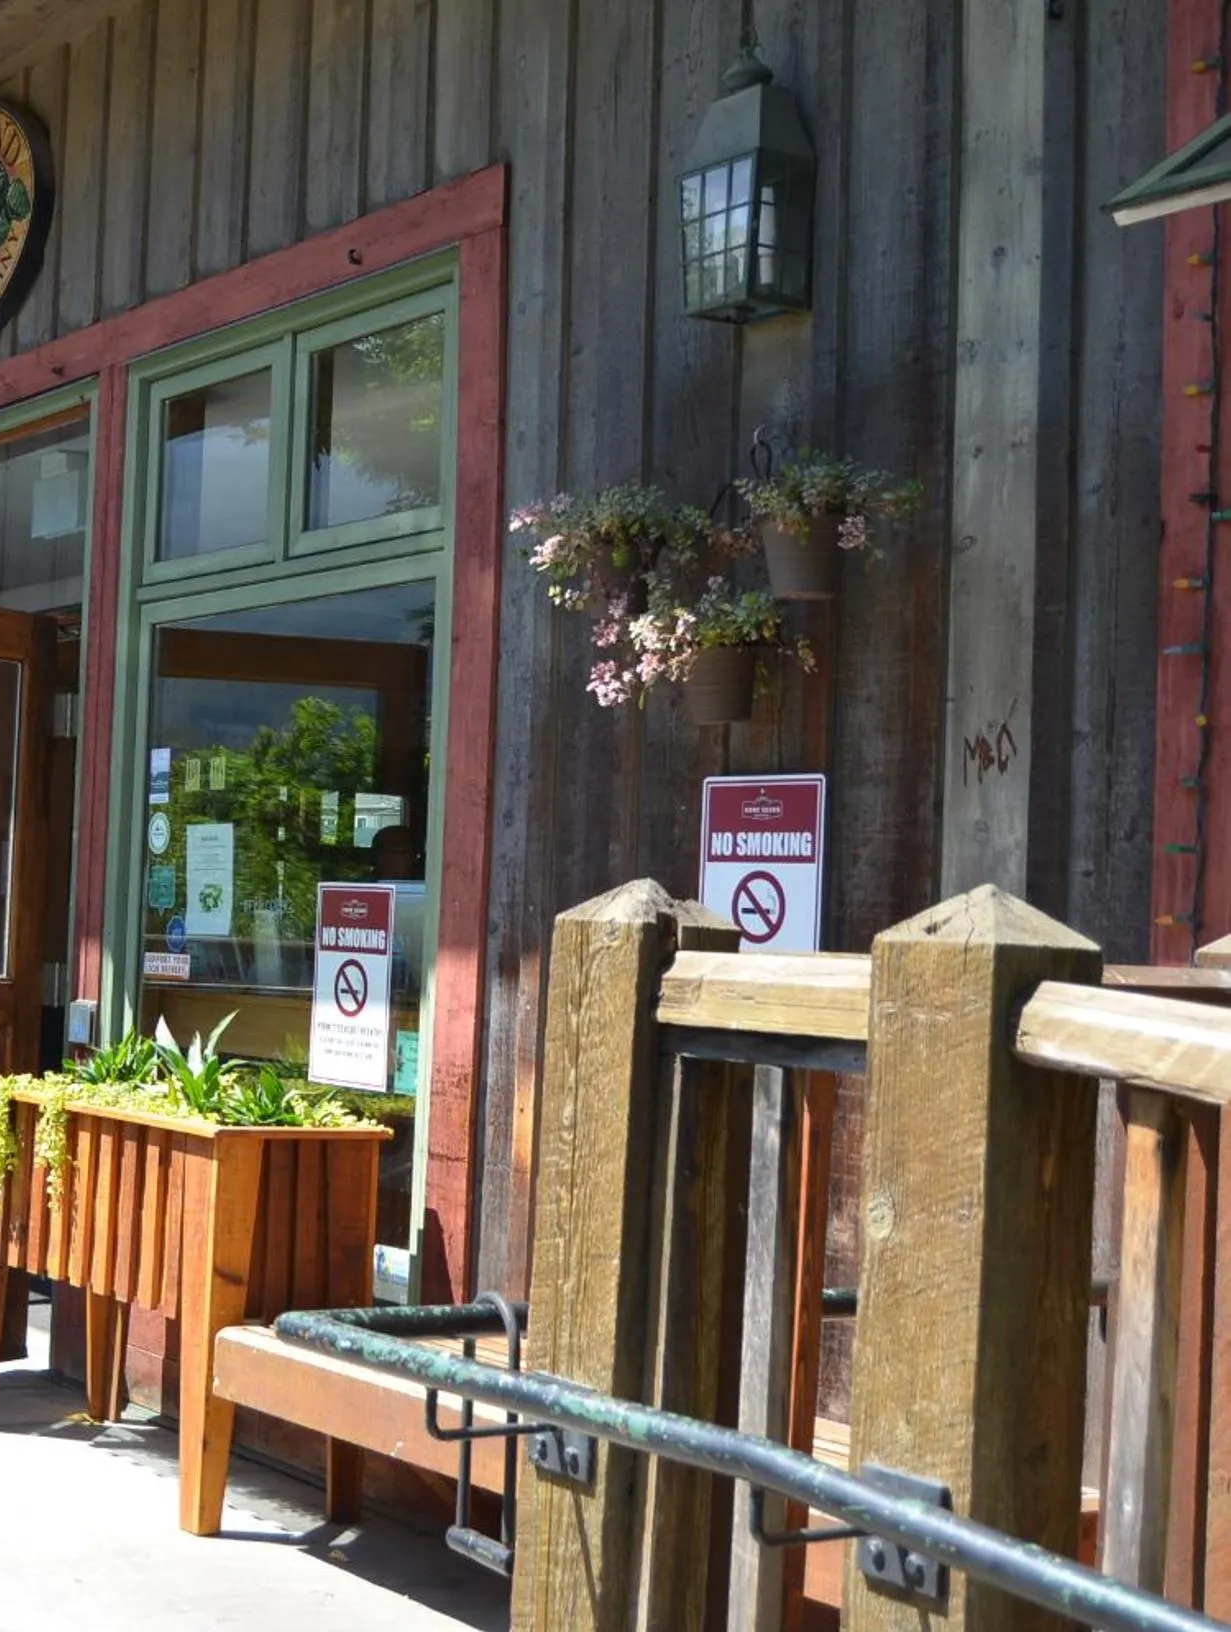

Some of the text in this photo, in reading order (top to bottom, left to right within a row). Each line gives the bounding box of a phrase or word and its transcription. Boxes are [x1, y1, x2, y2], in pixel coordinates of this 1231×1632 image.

[711, 831, 812, 856] NO SMOKING
[322, 926, 386, 950] NO SMOKING
